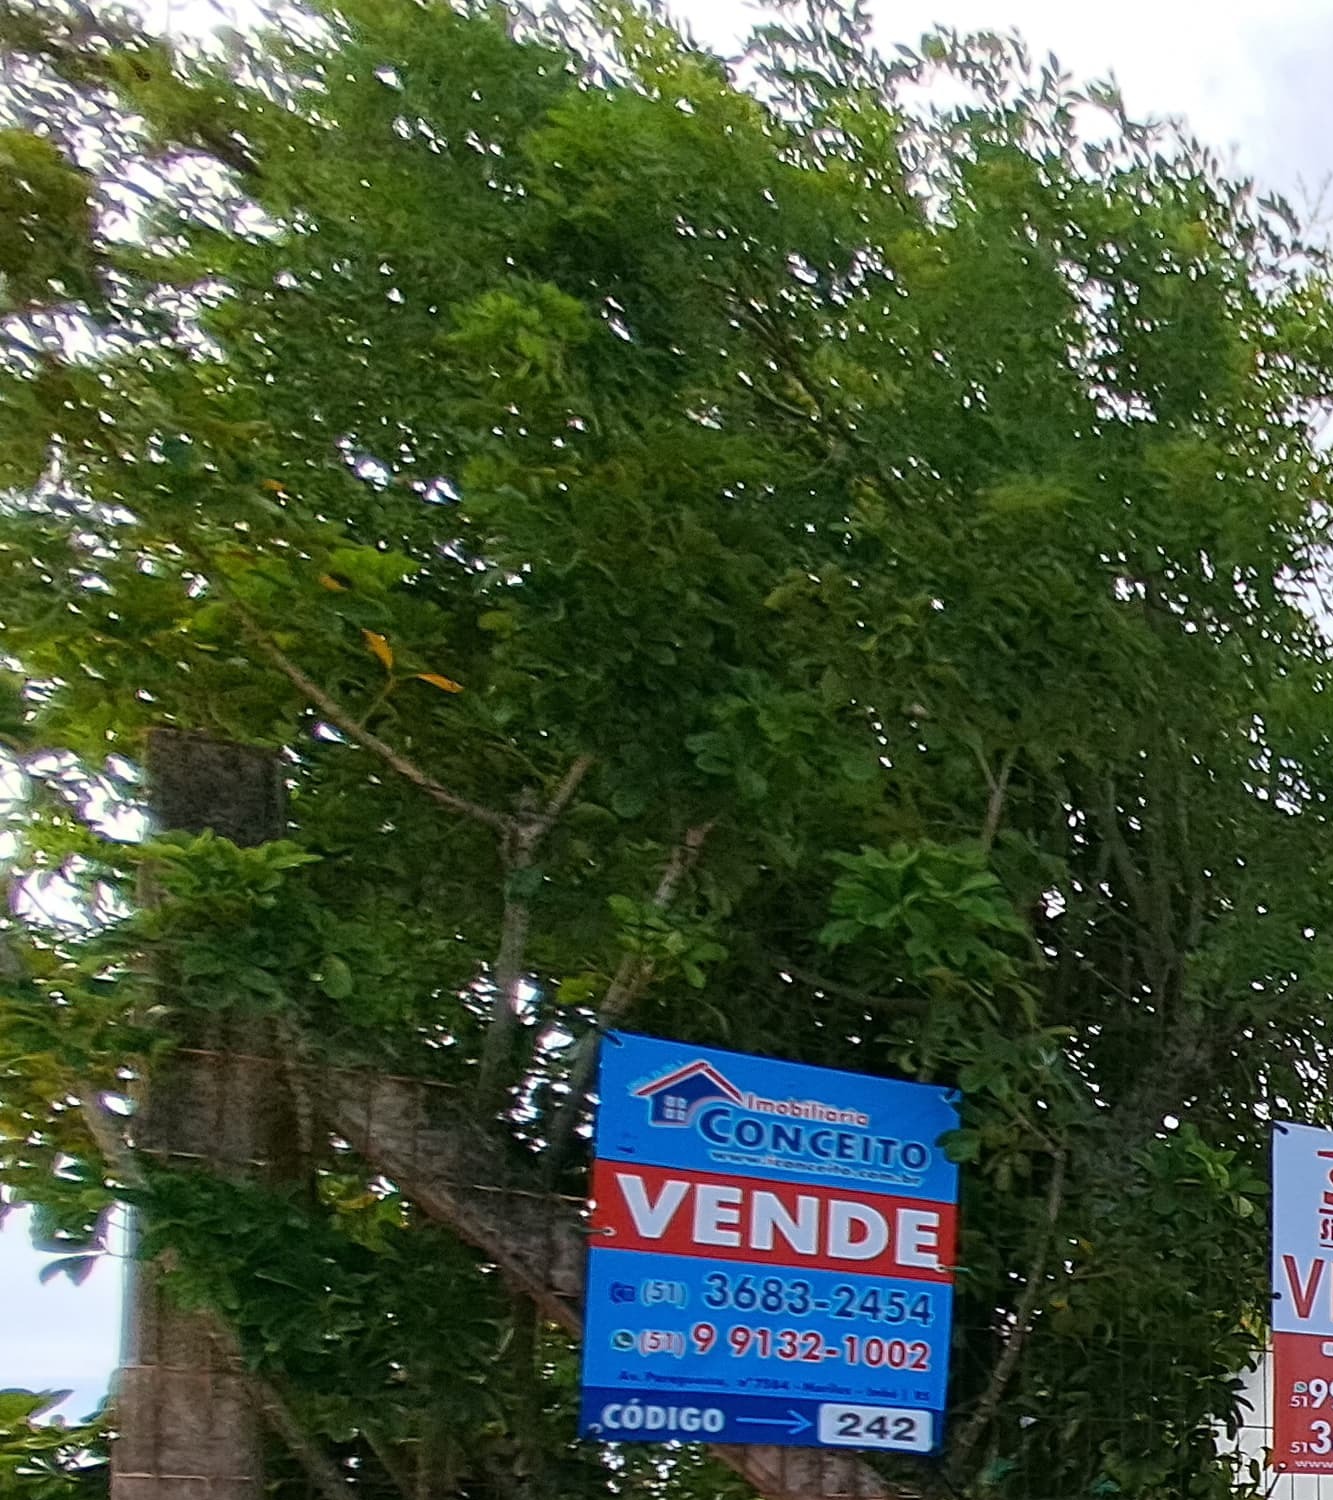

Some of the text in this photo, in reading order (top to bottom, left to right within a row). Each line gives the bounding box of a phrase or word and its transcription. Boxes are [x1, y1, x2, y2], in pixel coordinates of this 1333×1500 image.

[700, 1107, 929, 1172] CONCEITO
[616, 1173, 941, 1269] VENDE
[641, 1273, 934, 1326] (51) 3683-2454
[639, 1324, 930, 1372] (51) 9 9132-1002
[600, 1399, 918, 1443] CÓDIGO 242
